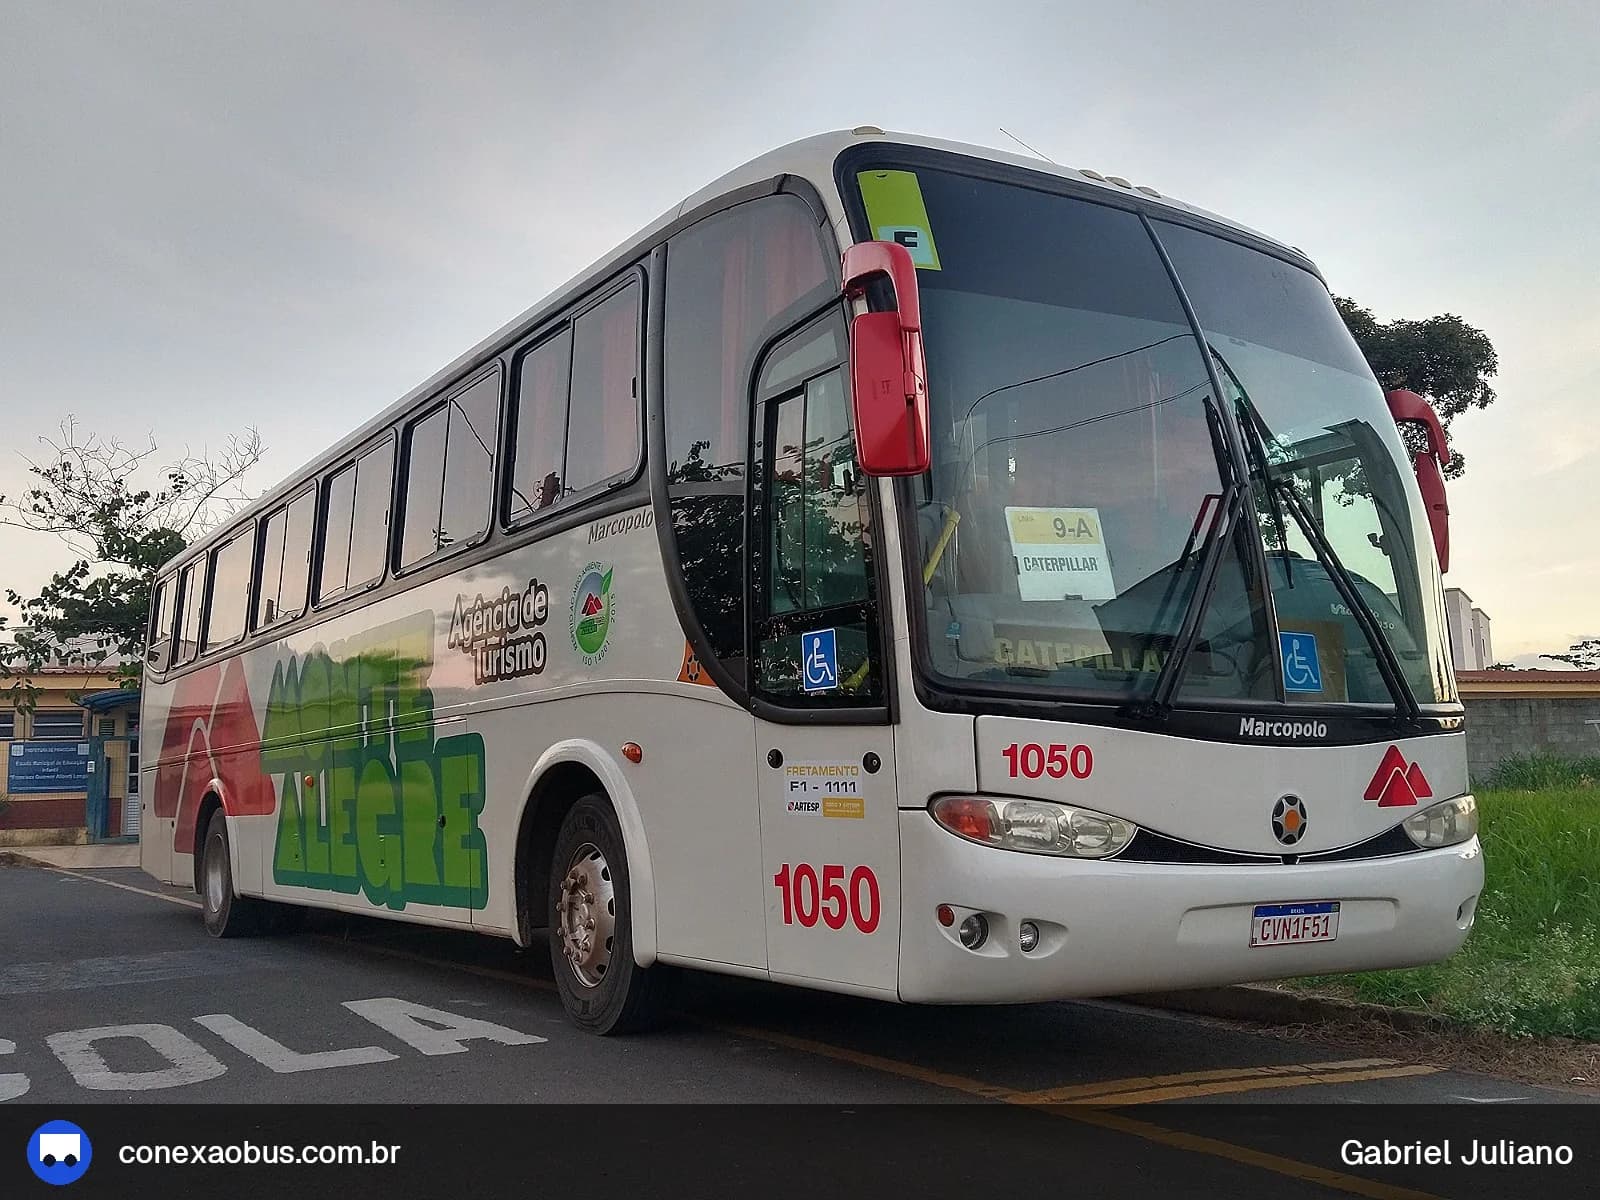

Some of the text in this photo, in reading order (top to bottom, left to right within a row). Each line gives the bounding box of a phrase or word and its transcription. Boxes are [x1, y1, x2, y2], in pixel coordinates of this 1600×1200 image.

[588, 511, 654, 544] Marcopolo
[1053, 517, 1094, 538] 9-A
[1023, 556, 1099, 572] CATERPILLAR
[449, 579, 549, 649] Agência de
[473, 633, 547, 684] Turismo
[1239, 717, 1327, 739] Marcopolo
[786, 766, 859, 776] FRETAMENTO
[1002, 743, 1093, 779] 1050
[790, 781, 807, 792] F1
[825, 781, 857, 793] 1111
[794, 801, 820, 812] ARTESP
[273, 737, 487, 908] ALEGRE
[774, 863, 881, 934] 1050
[1261, 915, 1330, 940] CVN1F51
